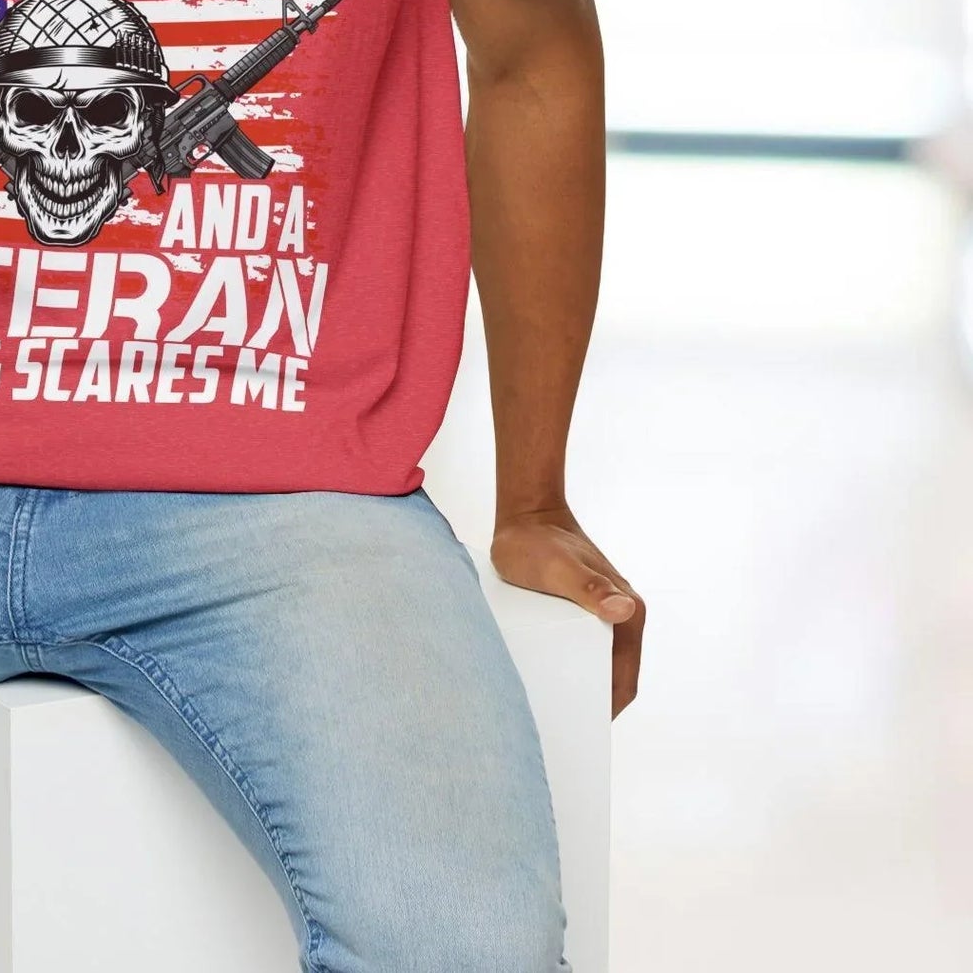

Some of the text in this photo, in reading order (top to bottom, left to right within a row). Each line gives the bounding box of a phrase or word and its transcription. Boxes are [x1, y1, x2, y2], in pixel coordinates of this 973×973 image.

[161, 183, 305, 253] AND A
[12, 339, 221, 403] SCARES
[230, 348, 309, 412] ME
